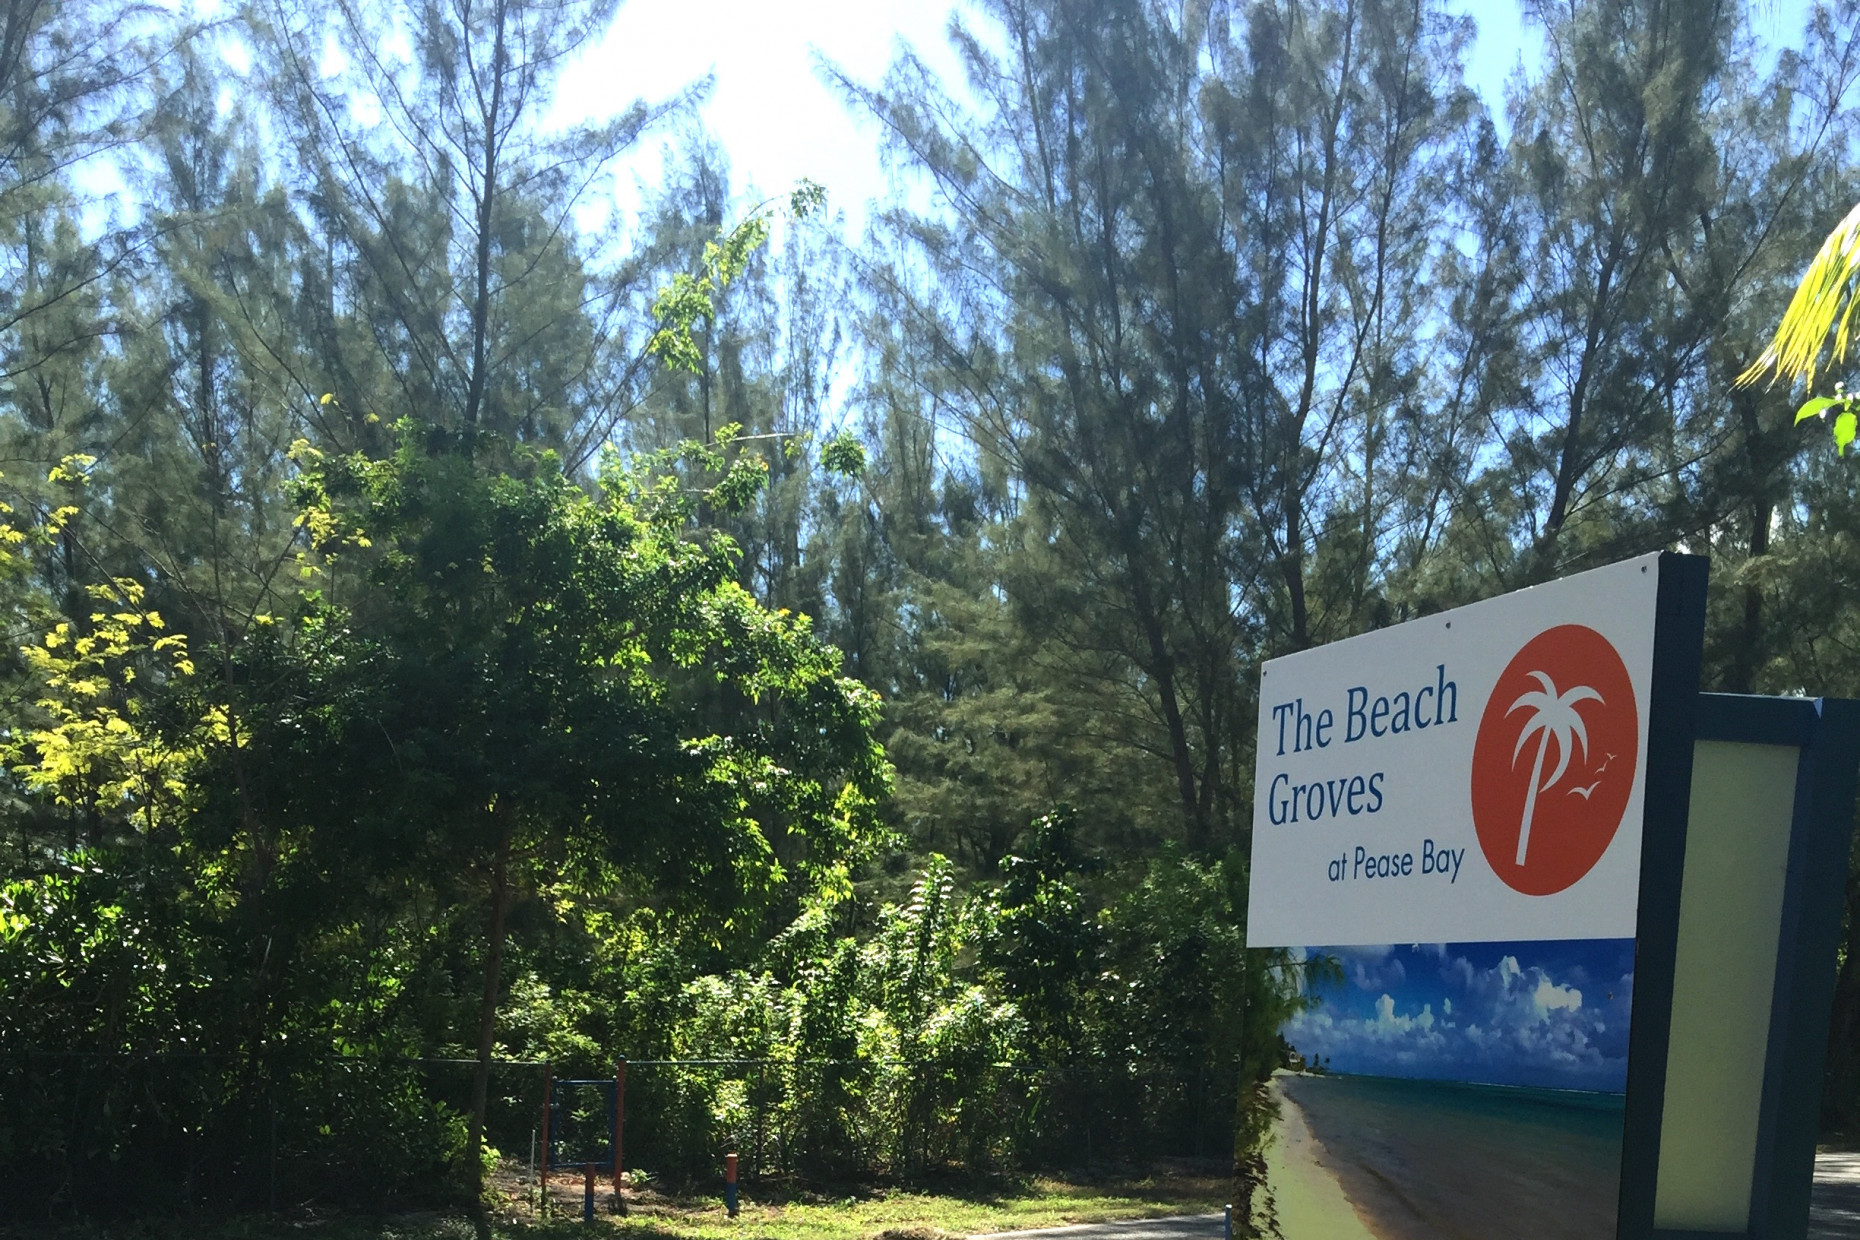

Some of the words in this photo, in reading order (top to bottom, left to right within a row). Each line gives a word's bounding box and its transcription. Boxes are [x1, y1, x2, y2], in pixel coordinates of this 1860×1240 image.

[1272, 697, 1333, 757] The
[1344, 663, 1459, 744] Beach
[1268, 772, 1385, 826] Groves
[1328, 851, 1348, 882] at
[1353, 845, 1414, 880] Pease
[1422, 838, 1466, 885] Bay
